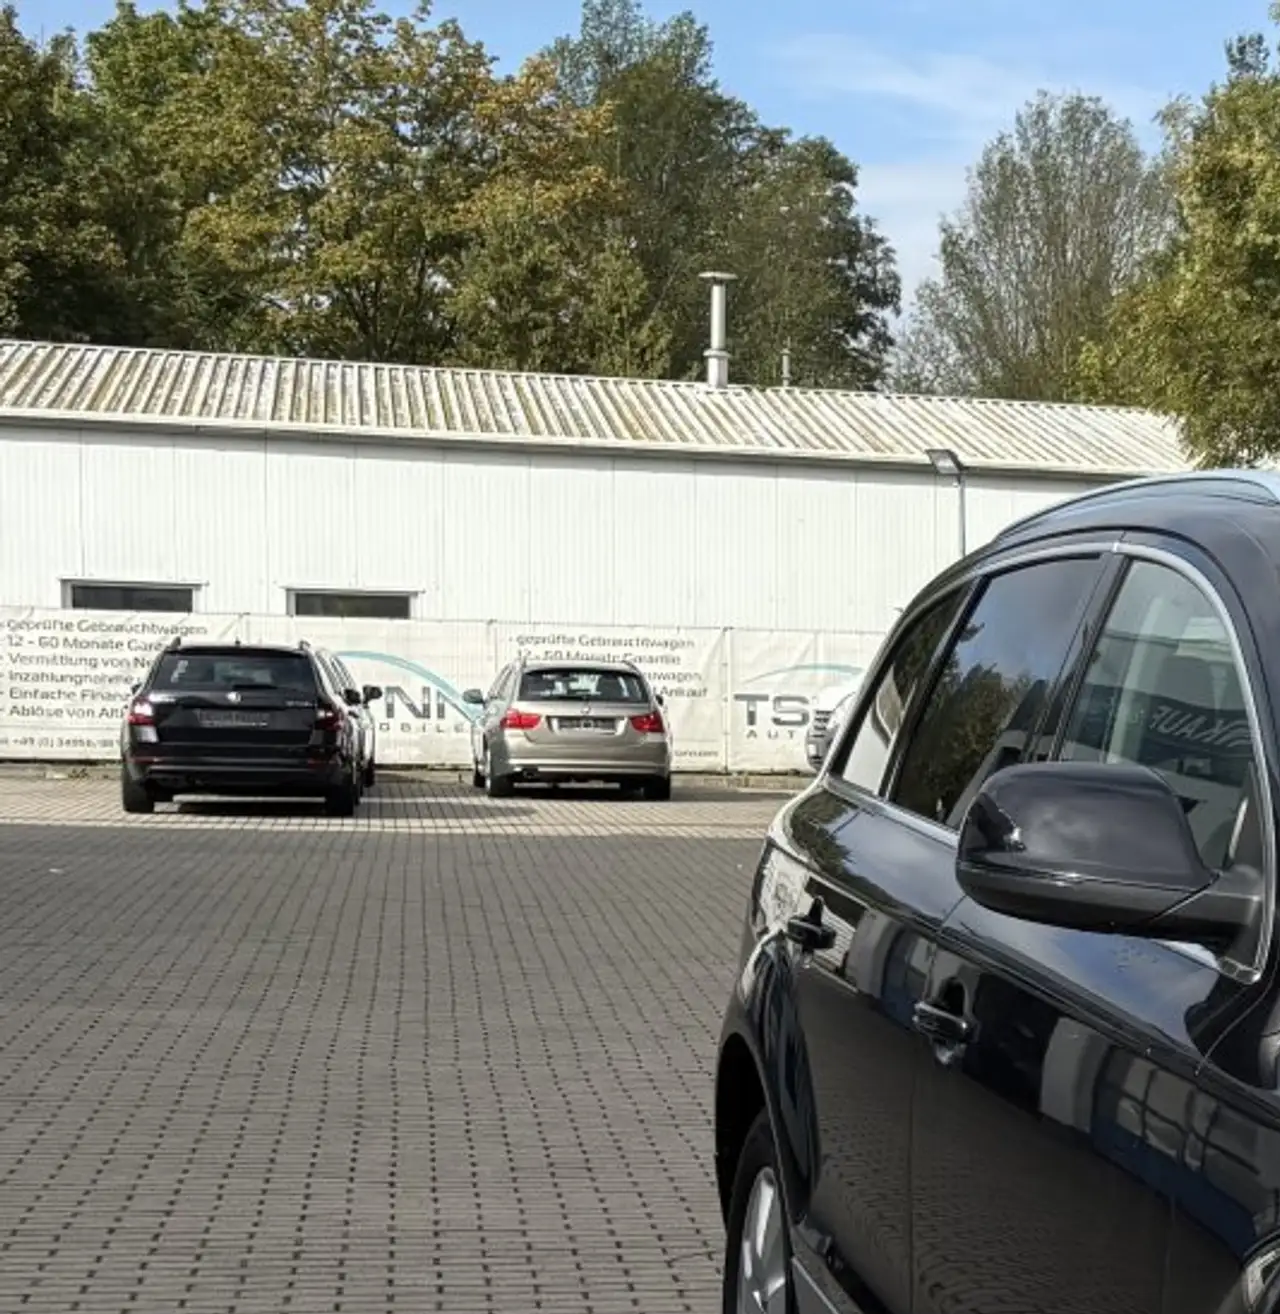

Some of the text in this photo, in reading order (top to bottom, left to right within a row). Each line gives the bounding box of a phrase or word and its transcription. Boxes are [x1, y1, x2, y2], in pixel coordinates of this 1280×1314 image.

[77, 619, 208, 637] Gebrauchtwagen
[63, 637, 124, 649] Monate
[579, 634, 695, 650] Gebrauchtwagen
[8, 652, 98, 668] Vermittlung
[101, 657, 130, 669] von
[9, 687, 77, 700] Einfache
[9, 705, 64, 718] Ablöse
[67, 709, 95, 720] von
